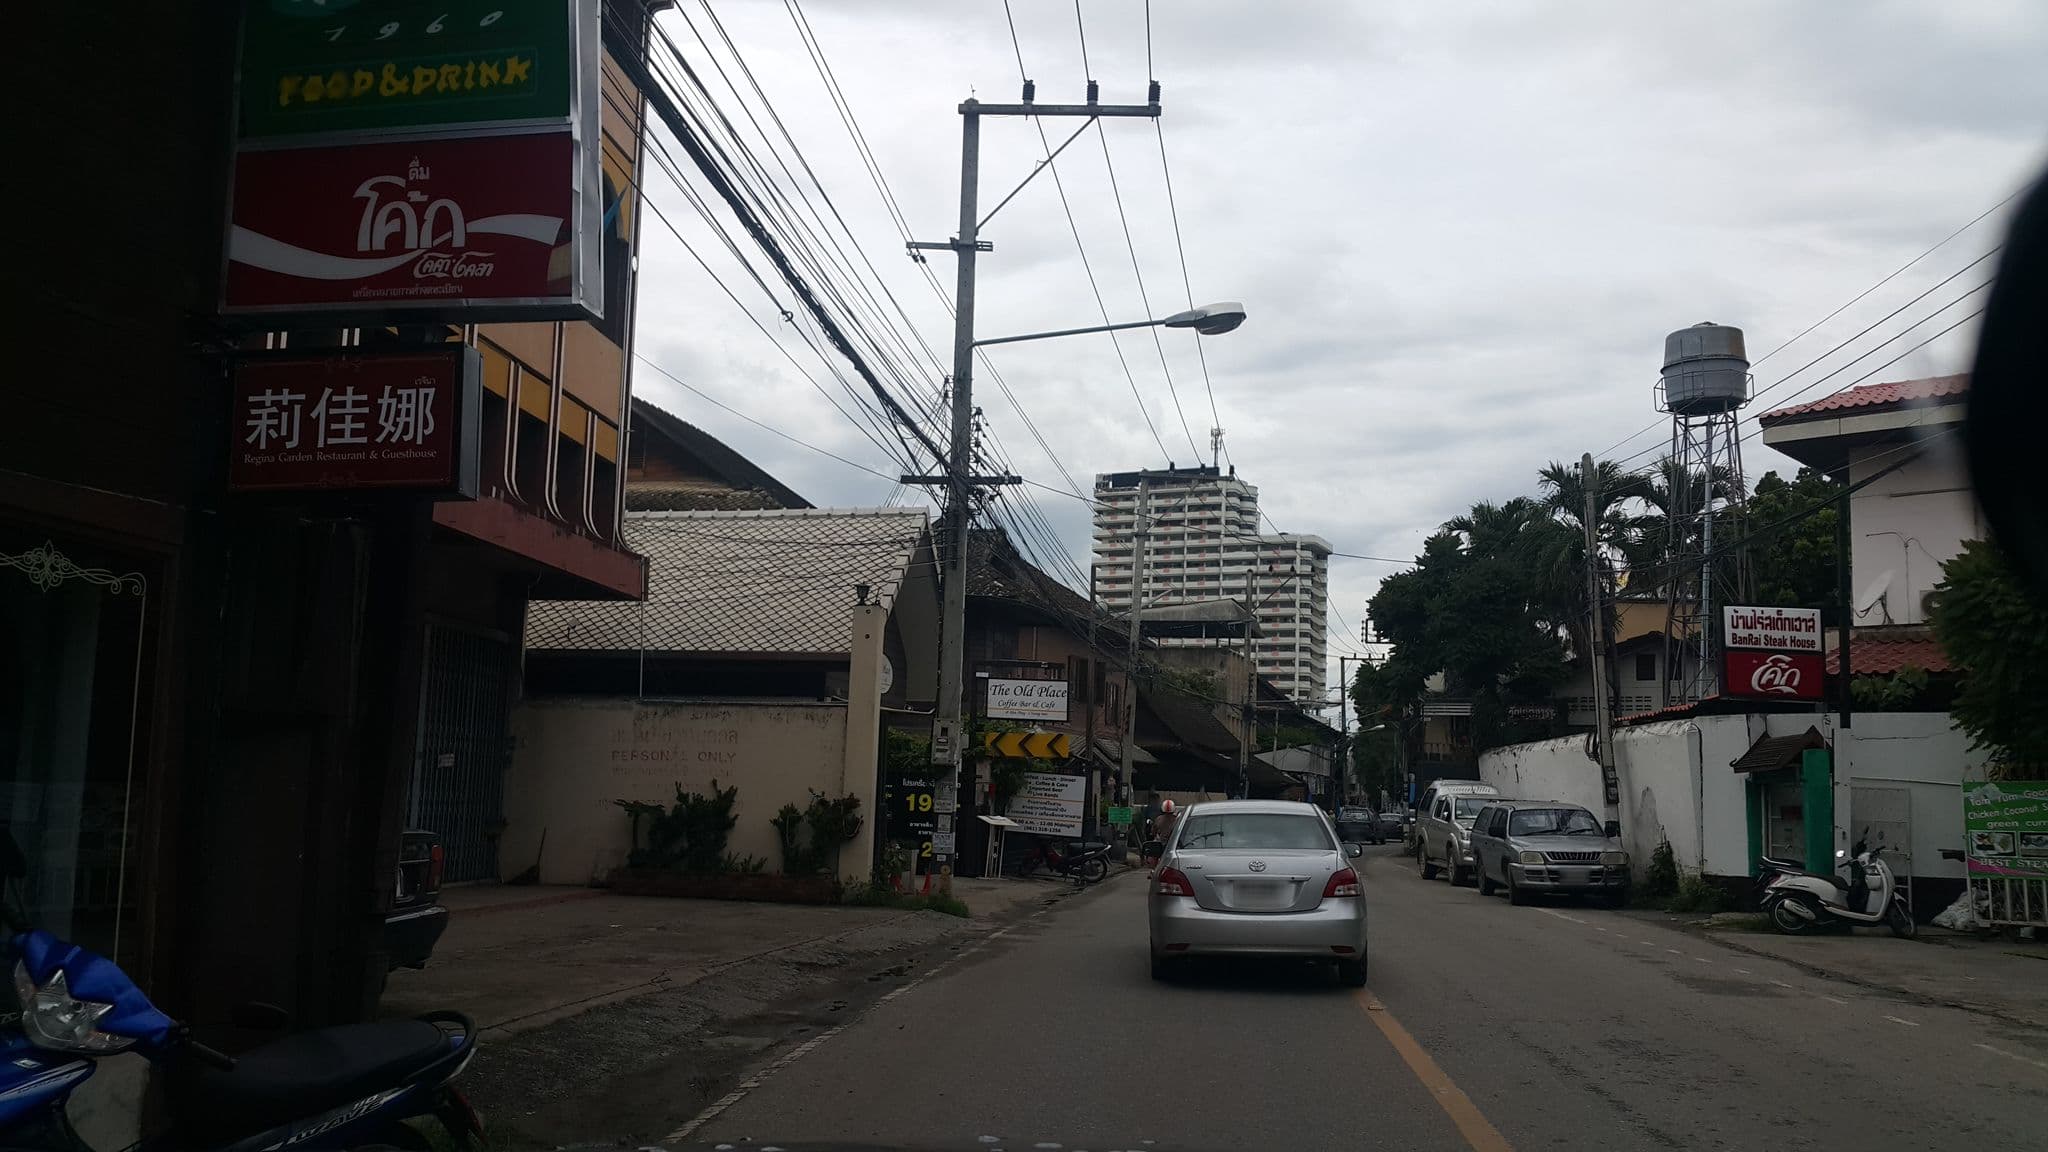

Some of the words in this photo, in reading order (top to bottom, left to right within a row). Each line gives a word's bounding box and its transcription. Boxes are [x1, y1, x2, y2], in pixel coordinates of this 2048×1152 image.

[245, 385, 437, 450] 莉佳娜
[243, 453, 276, 465] Regina
[278, 452, 313, 463] Garden
[316, 450, 366, 462] Restaurant
[369, 450, 379, 460] &
[381, 448, 437, 460] Guesthouse
[1731, 633, 1761, 646] BanRai
[1763, 634, 1788, 648] Steak
[1789, 636, 1816, 649] House
[990, 683, 1011, 696] The
[1013, 684, 1036, 697] Old
[1037, 685, 1067, 698] Place
[997, 699, 1019, 709] Coffee
[1020, 700, 1032, 708] Bar
[697, 750, 738, 763] ONLY
[1969, 798, 1992, 807] Tom
[1968, 809, 2001, 820] Chicken
[2003, 805, 2038, 816] Coconut
[1986, 820, 2019, 830] green
[1979, 858, 2011, 868] BEST
